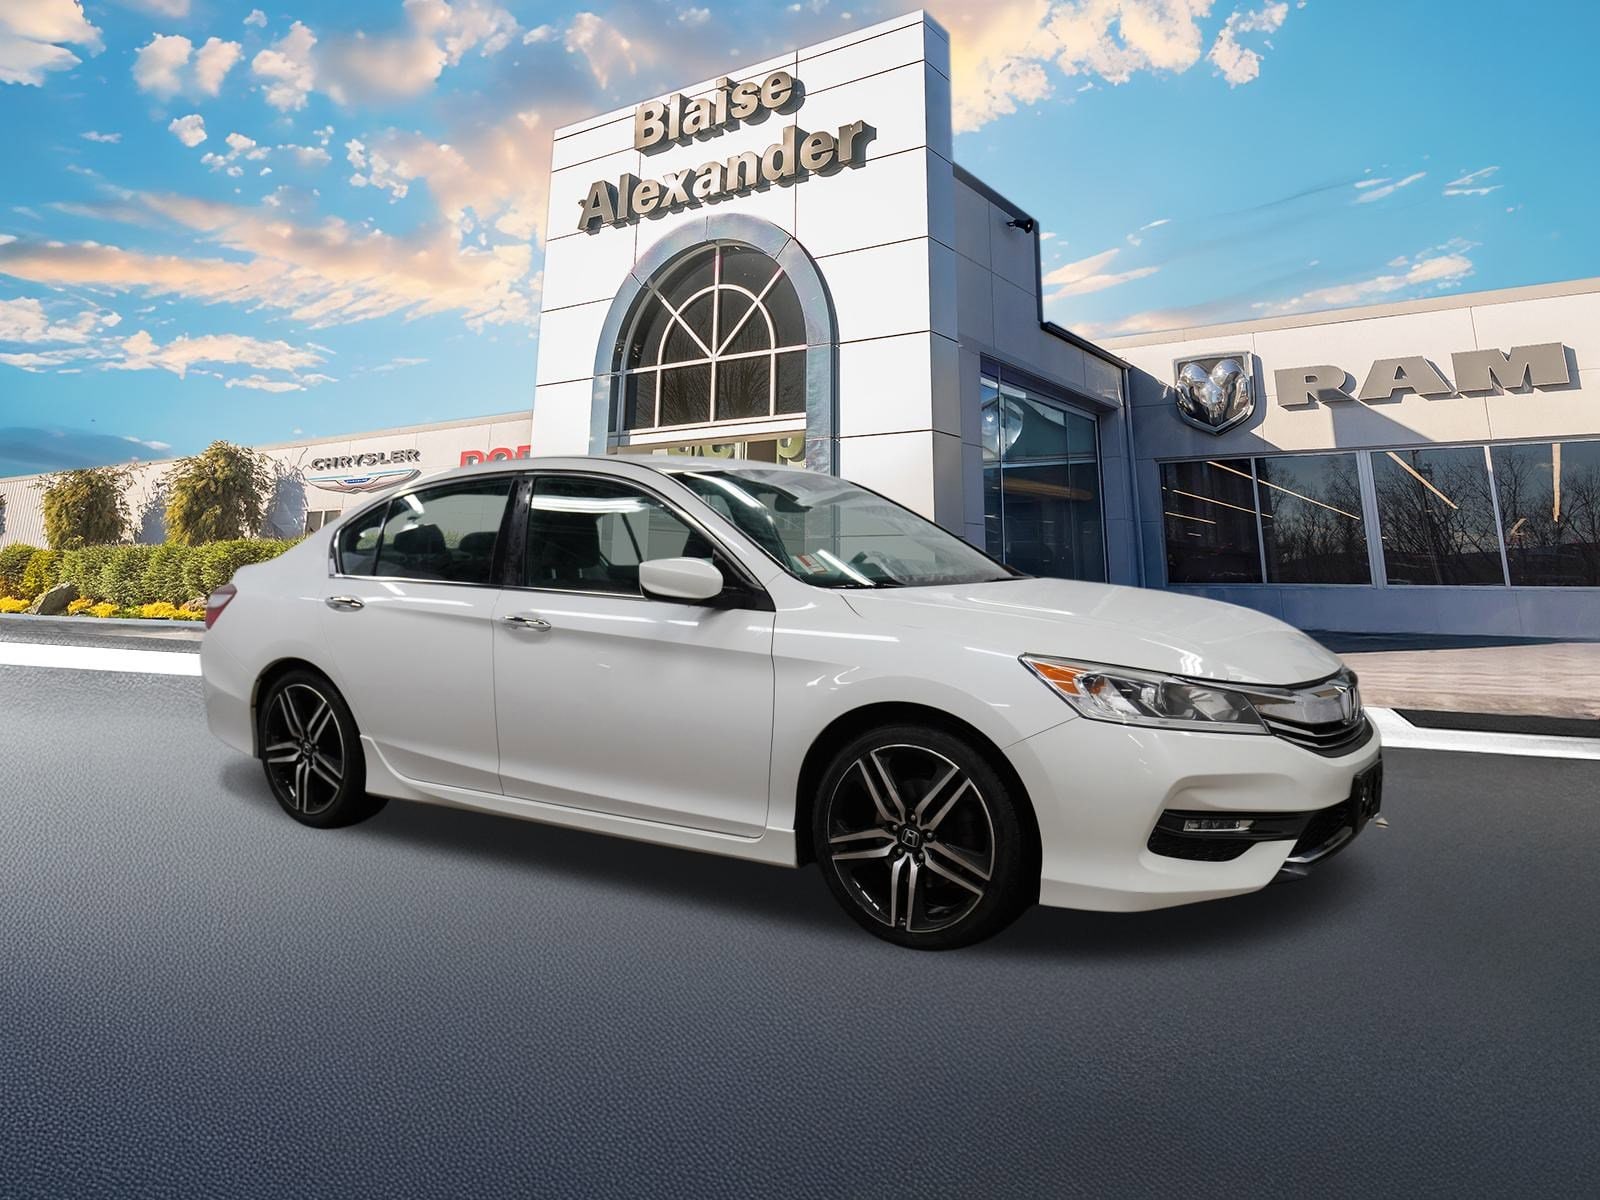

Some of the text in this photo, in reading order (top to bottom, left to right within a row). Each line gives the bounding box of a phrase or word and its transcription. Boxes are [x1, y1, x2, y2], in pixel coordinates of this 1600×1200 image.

[635, 71, 804, 155] Blaise
[577, 119, 876, 234] Alexander
[1274, 342, 1573, 408] RAM
[311, 448, 420, 471] CHRYSLER
